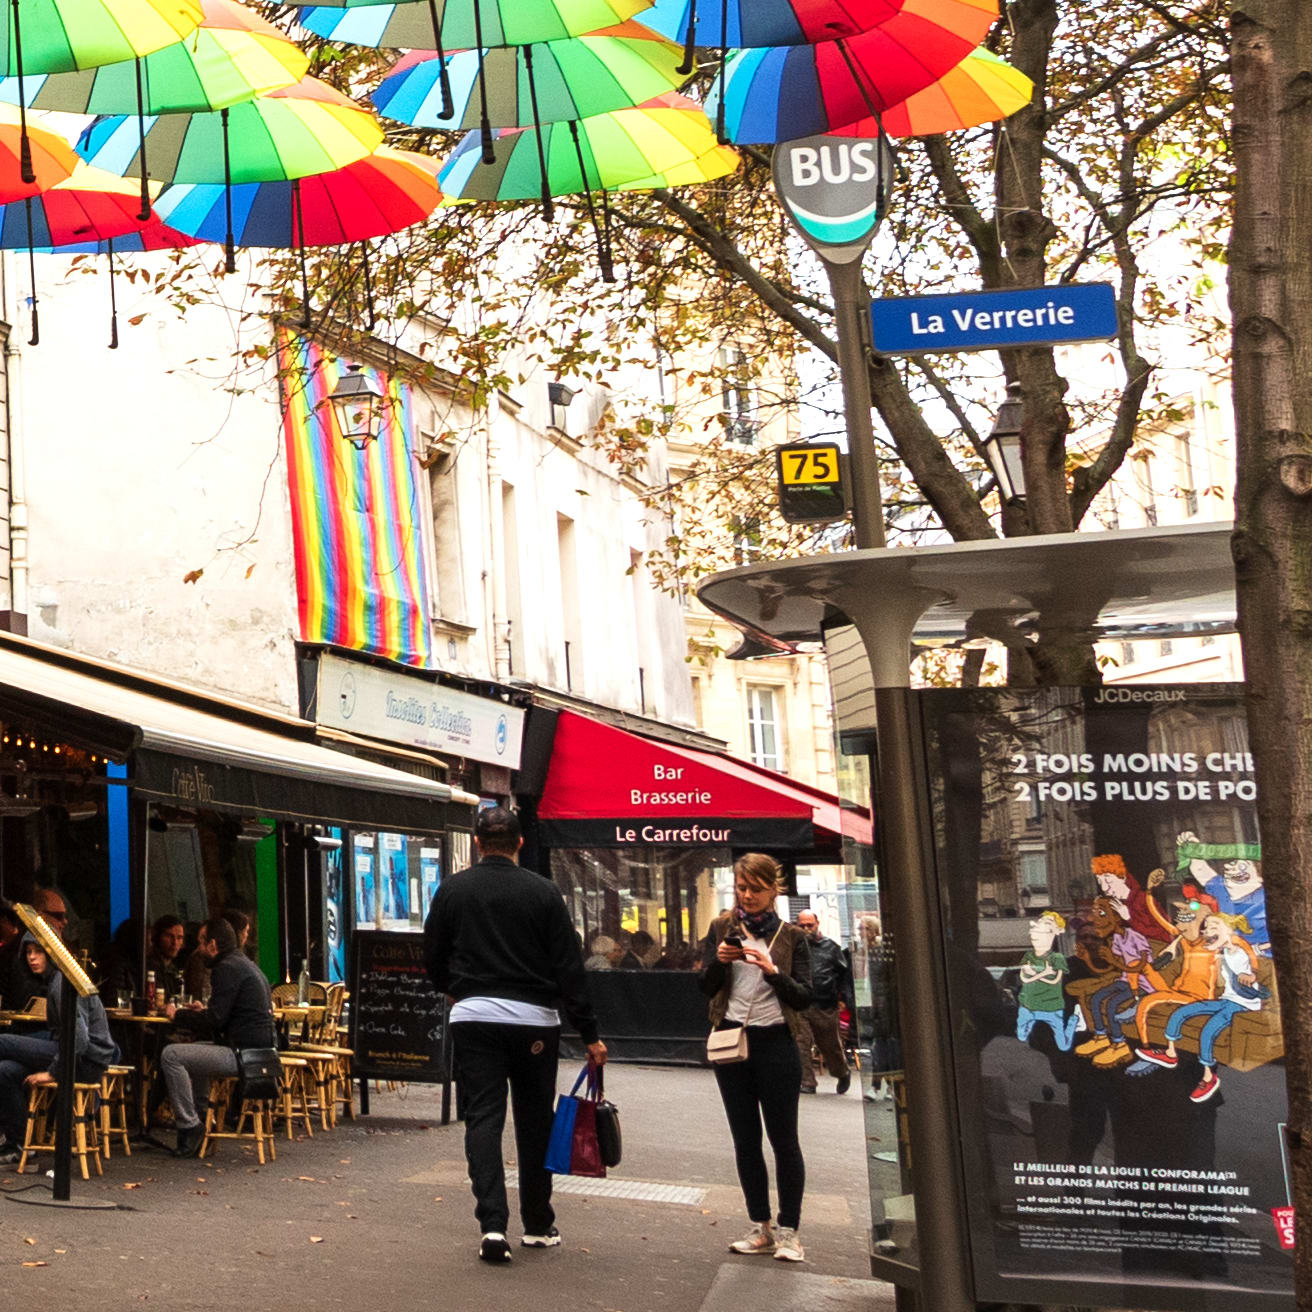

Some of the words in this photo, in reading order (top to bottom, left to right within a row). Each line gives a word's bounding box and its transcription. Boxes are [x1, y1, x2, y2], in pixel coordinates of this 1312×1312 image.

[790, 141, 876, 187] BUS
[910, 311, 945, 335] La
[951, 301, 1075, 332] Verrerie
[788, 452, 831, 481] 75
[1094, 688, 1187, 703] JCDecaux
[653, 764, 684, 780] Bar
[1011, 754, 1029, 774] 2
[1035, 753, 1095, 773] FOIS
[1102, 752, 1199, 773] MOINS
[630, 788, 712, 805] Brasserie
[1013, 783, 1031, 802] 2
[1038, 782, 1098, 801] FOIS
[1104, 782, 1171, 801] PLUS
[1176, 781, 1212, 801] DE
[616, 826, 636, 842] Le
[641, 824, 731, 842] Carrefour
[1013, 1162, 1025, 1172] LE
[1026, 1163, 1076, 1174] MEILLEUR
[1078, 1164, 1092, 1175] DE
[1094, 1166, 1108, 1175] LA
[1109, 1166, 1141, 1177] LIGUE
[1014, 1176, 1026, 1185] ET
[1027, 1176, 1045, 1186] LES
[1046, 1177, 1094, 1188] GRANDS
[1095, 1179, 1140, 1190] MATCHS
[1141, 1181, 1156, 1191] DE
[1158, 1182, 1205, 1194] PREMIER
[1207, 1184, 1250, 1196] LEAGUE
[1037, 1196, 1062, 1204] aussi
[1062, 1197, 1082, 1205] 300
[1083, 1197, 1106, 1206] films
[1139, 1201, 1156, 1209] par
[1173, 1202, 1188, 1210] les
[1189, 1204, 1228, 1213] grandes
[1085, 1208, 1096, 1216] et
[1096, 1208, 1126, 1217] toutes
[1127, 1209, 1140, 1218] les
[1141, 1210, 1186, 1221] Créations
